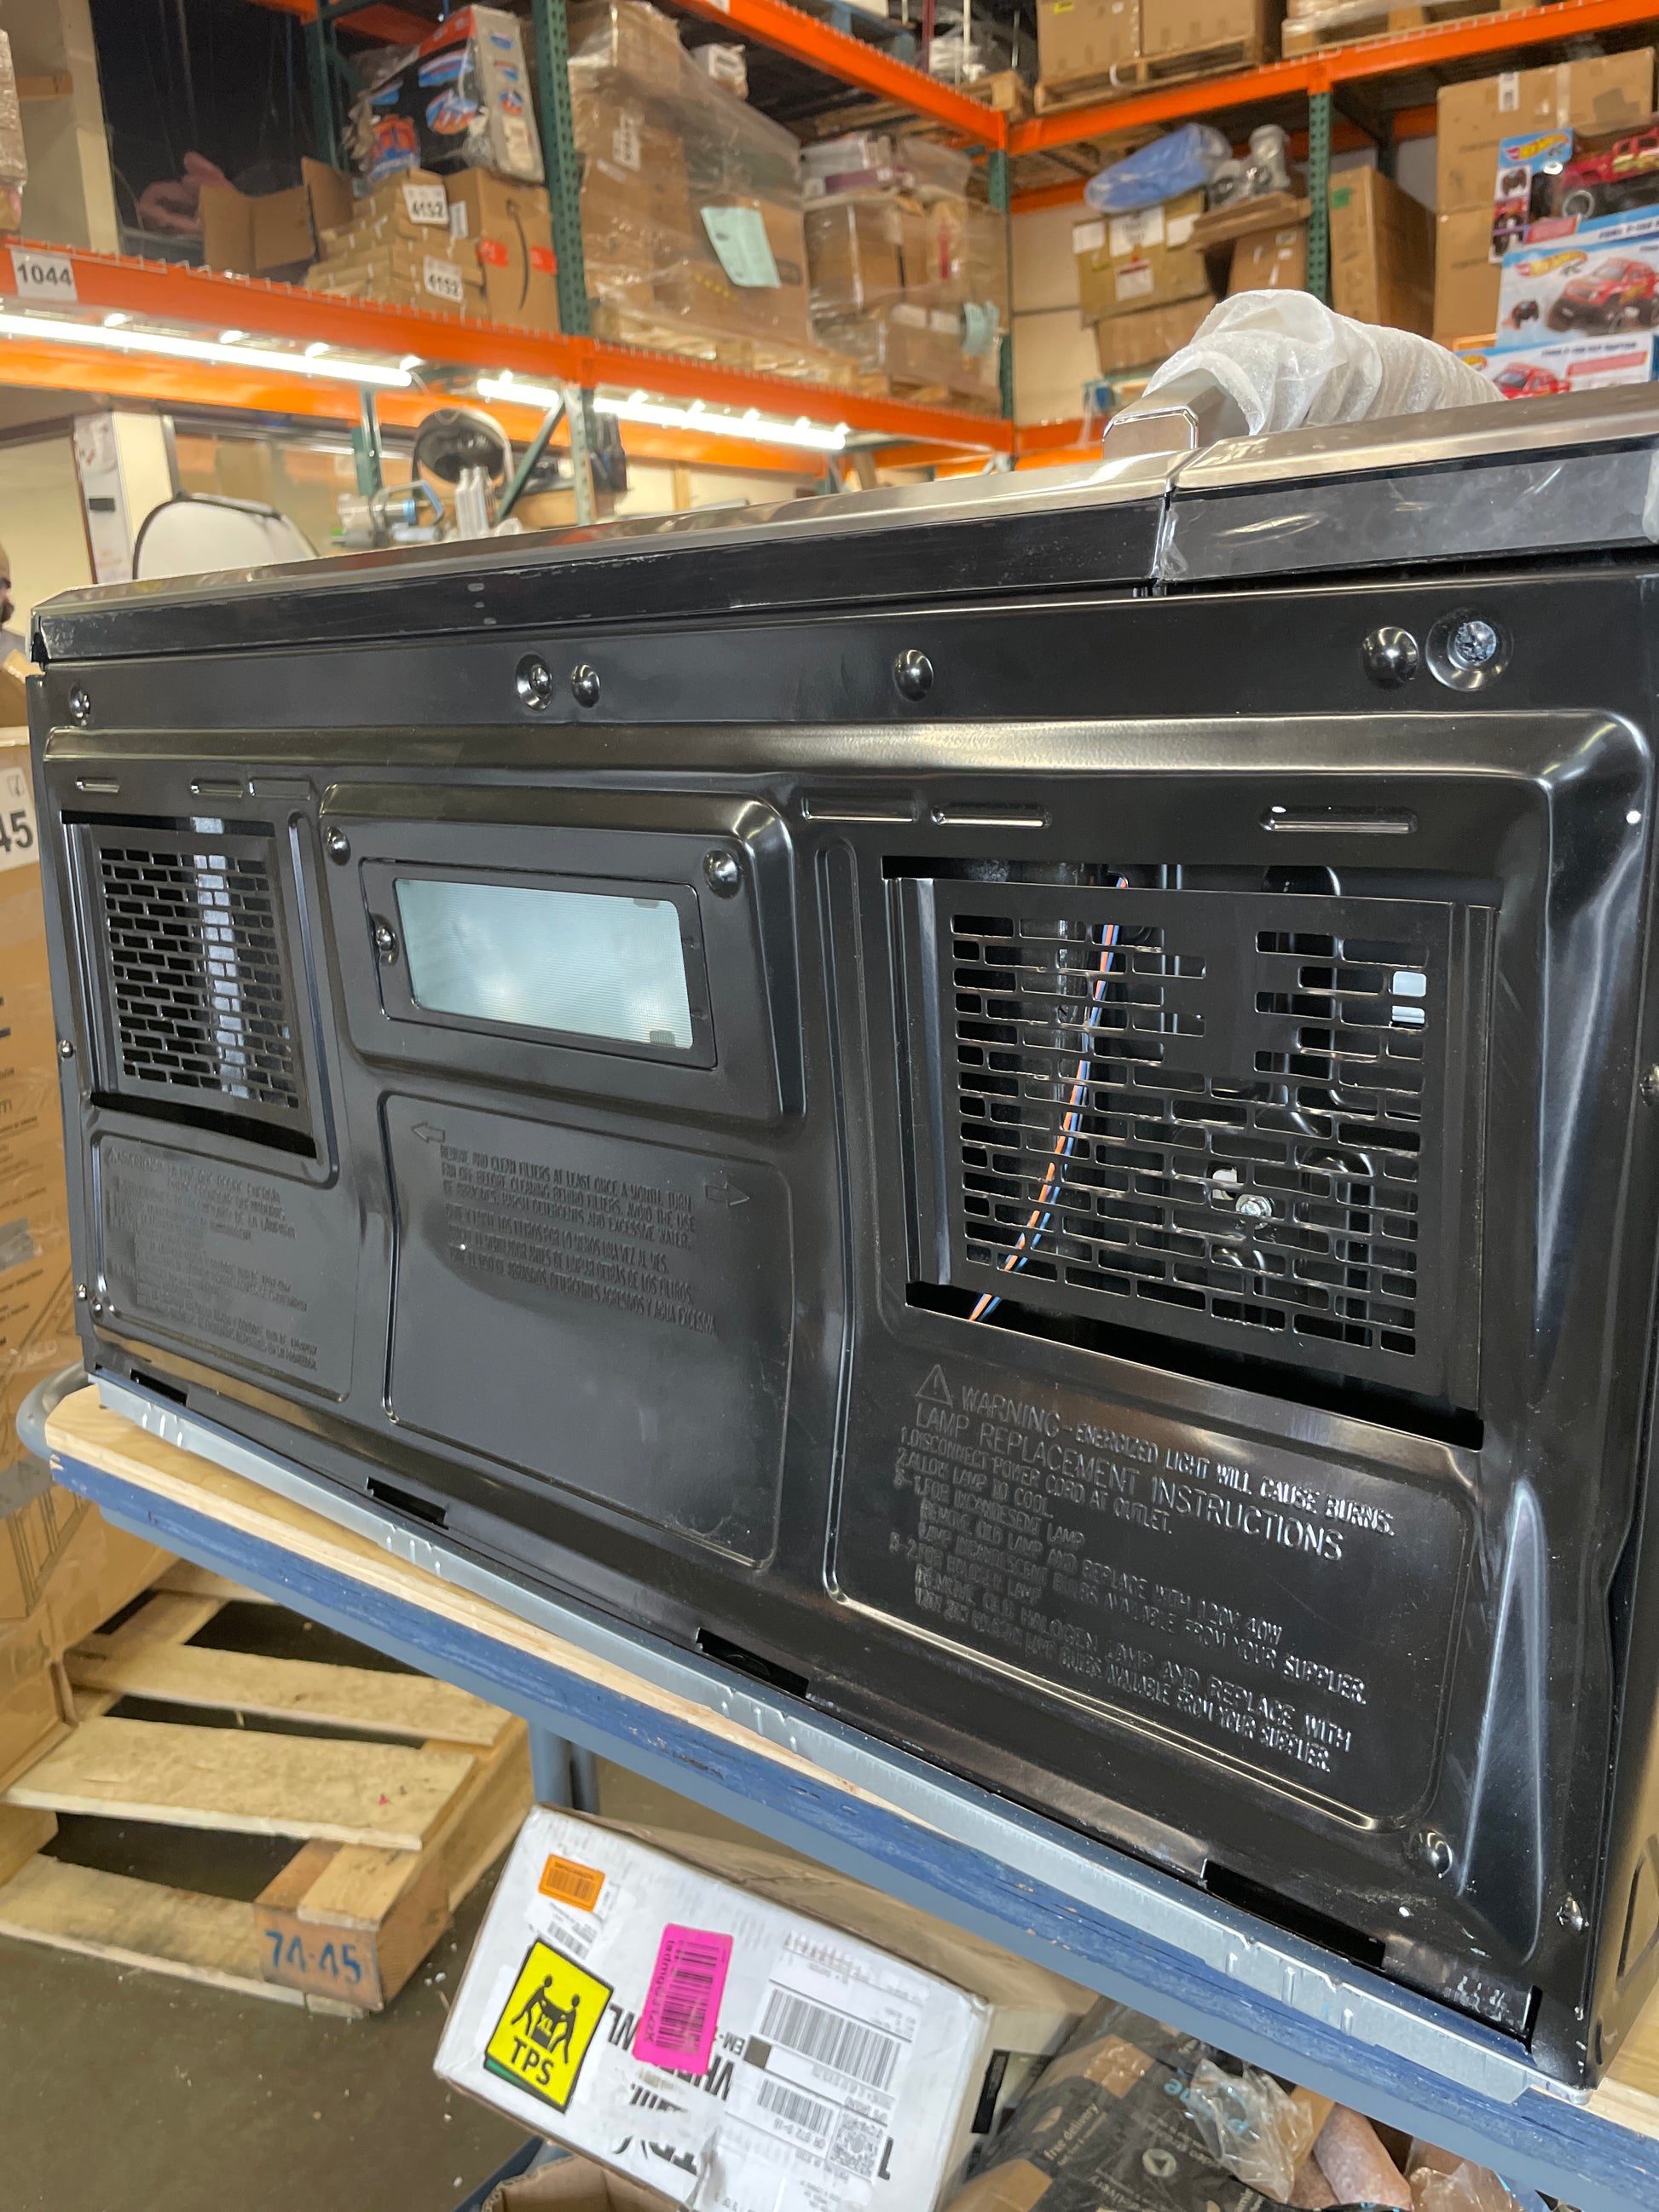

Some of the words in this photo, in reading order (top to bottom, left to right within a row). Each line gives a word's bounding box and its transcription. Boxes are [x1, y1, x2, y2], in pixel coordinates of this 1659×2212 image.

[17, 263, 72, 286] 1044
[916, 1401, 970, 1443] LAMP
[979, 1420, 1140, 1498] REPLACEMENT
[1149, 1474, 1344, 1564] INSTRUCTIONS
[951, 1464, 987, 1495] LAMP
[991, 1477, 1010, 1503] TO
[991, 1454, 1040, 1490] POWER
[1043, 1471, 1086, 1505] CORD
[1089, 1486, 1108, 1512] AT
[1164, 1446, 1211, 1481] LIGHT
[1214, 1461, 1254, 1495] WILL
[1258, 1473, 1321, 1515] CAUSE
[1324, 1492, 1398, 1538] BURNS.
[1046, 1520, 1086, 1555] LAMP
[1206, 1673, 1296, 1731] REPLACE
[1302, 1711, 1352, 1754] WITH
[513, 2035, 554, 2086] TPS
